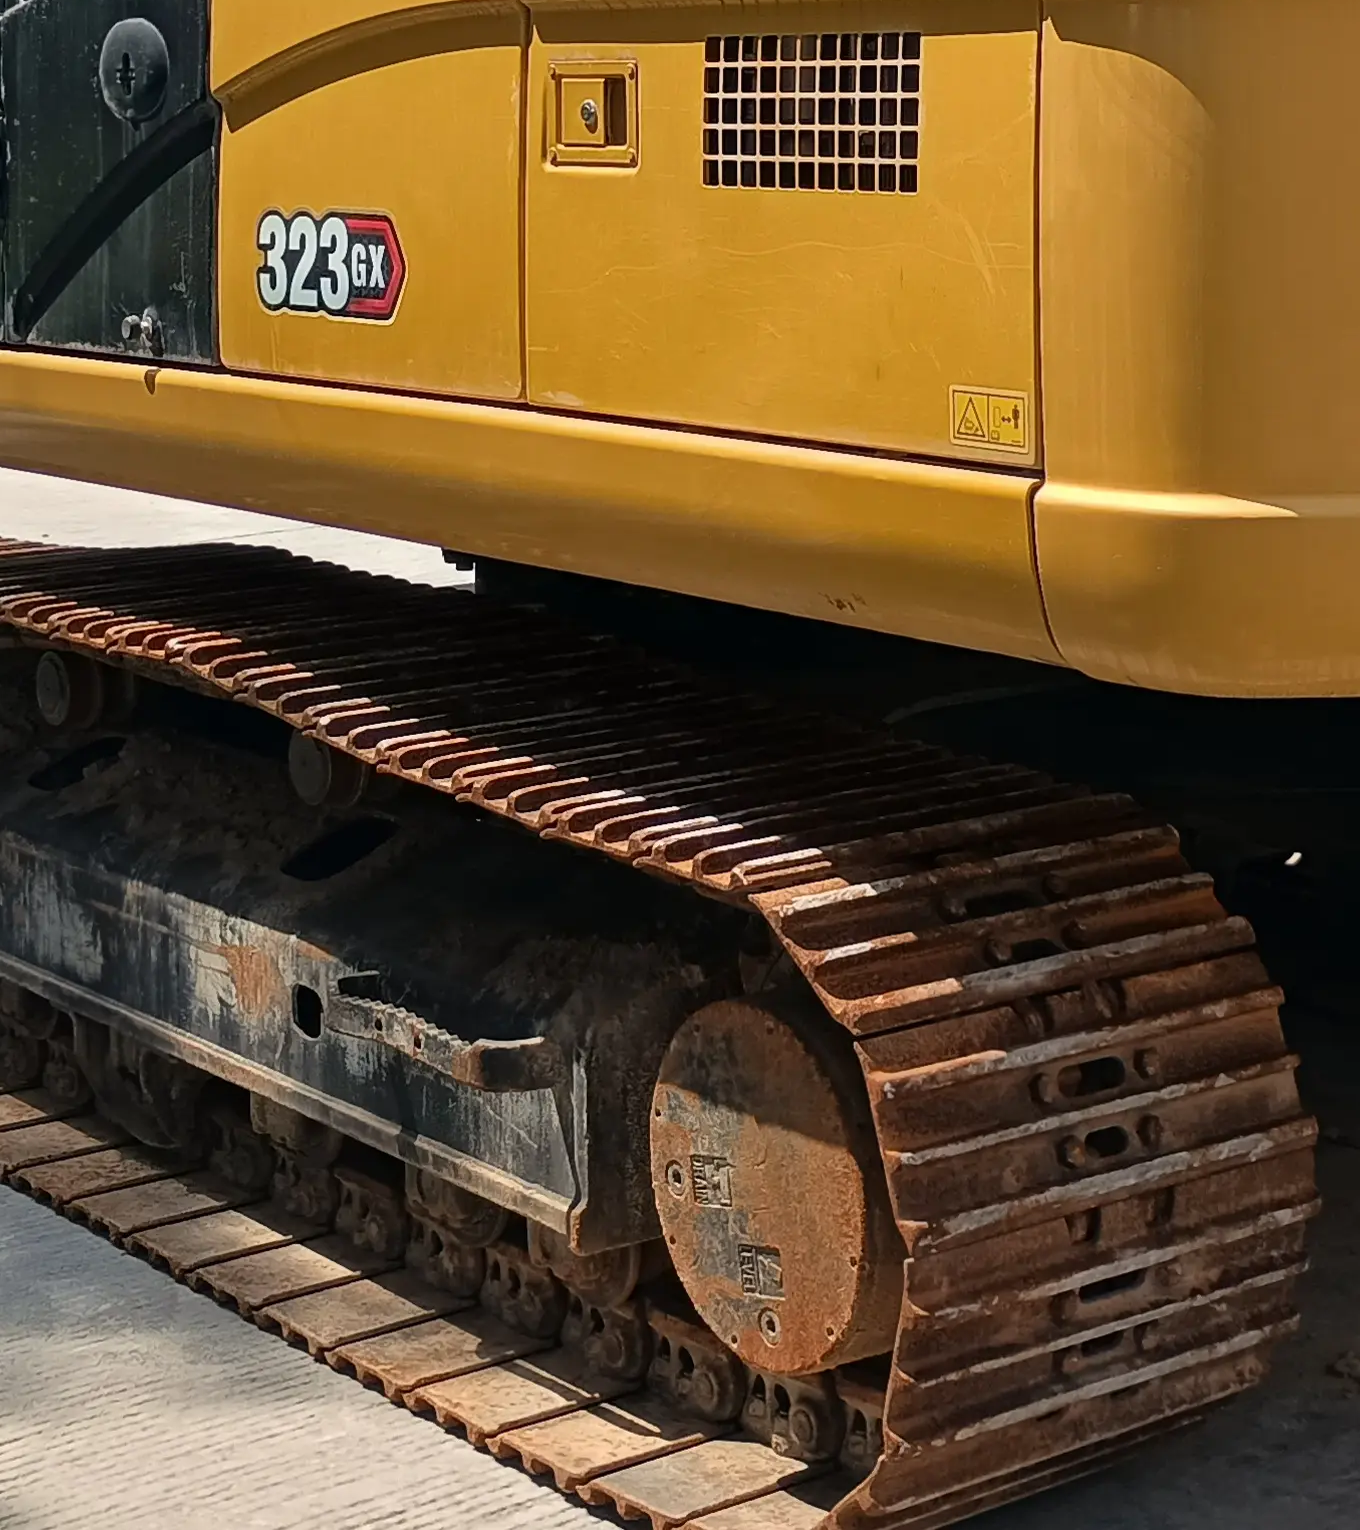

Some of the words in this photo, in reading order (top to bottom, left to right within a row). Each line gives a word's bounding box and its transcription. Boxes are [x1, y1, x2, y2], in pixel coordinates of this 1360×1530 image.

[258, 214, 349, 310] 323
[351, 243, 386, 289] GX
[692, 1156, 709, 1205] DRAIN
[739, 1246, 757, 1293] LEVEL
